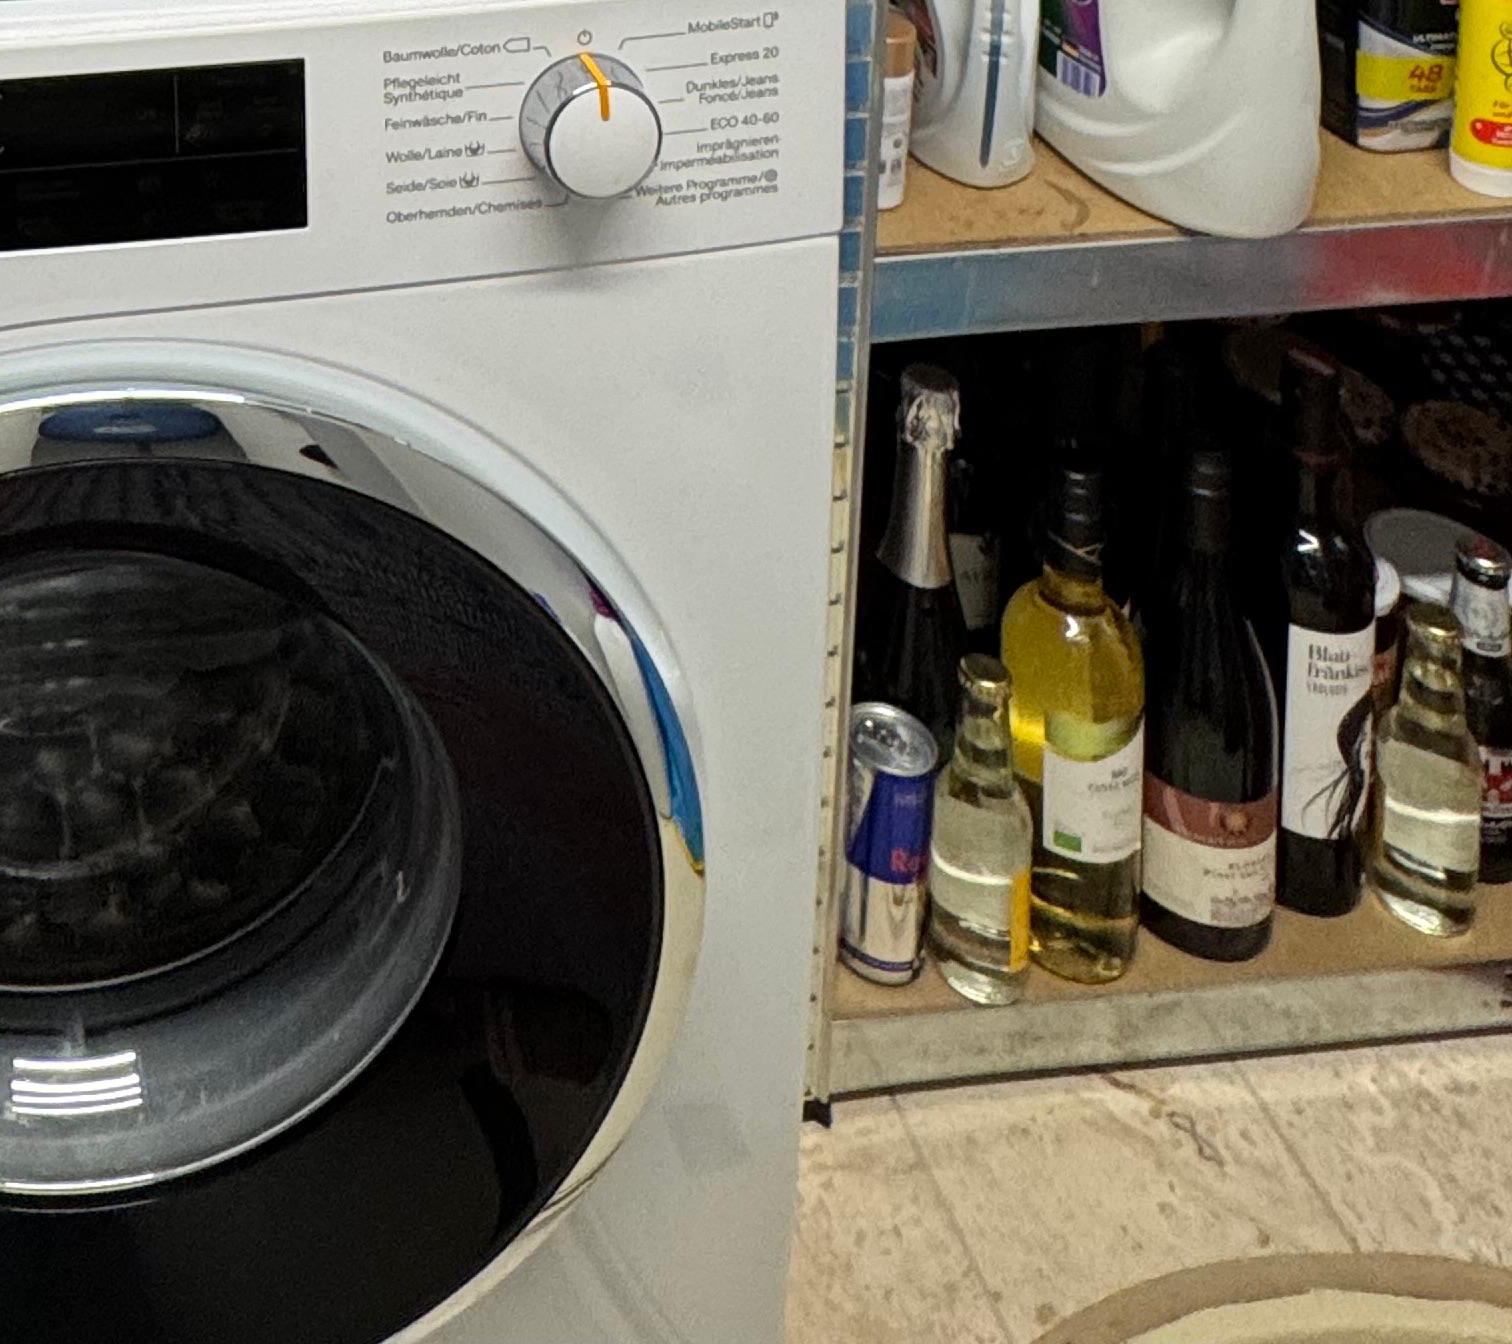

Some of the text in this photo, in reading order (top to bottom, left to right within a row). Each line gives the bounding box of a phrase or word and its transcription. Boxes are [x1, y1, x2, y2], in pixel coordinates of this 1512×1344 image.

[687, 15, 761, 35] MobileStart
[383, 44, 501, 64] Baumwolle/Coton
[710, 46, 780, 67] Express 20
[383, 72, 462, 93] Pflegeleicht
[686, 73, 780, 95] Dunkles/Jeans
[383, 87, 464, 107] Synthétique
[698, 87, 780, 105] Foncé/Jeans
[384, 111, 487, 131] Feinwäsche/Fin
[710, 112, 780, 131] ECO 40-60
[696, 134, 780, 155] Imprägnieren
[385, 147, 463, 165] Wolle/Laine
[386, 178, 458, 196] Seide/Soie
[635, 182, 684, 198] Weitere
[654, 183, 779, 208] Autres programmes
[386, 197, 544, 224] Oberhemden/Chemises
